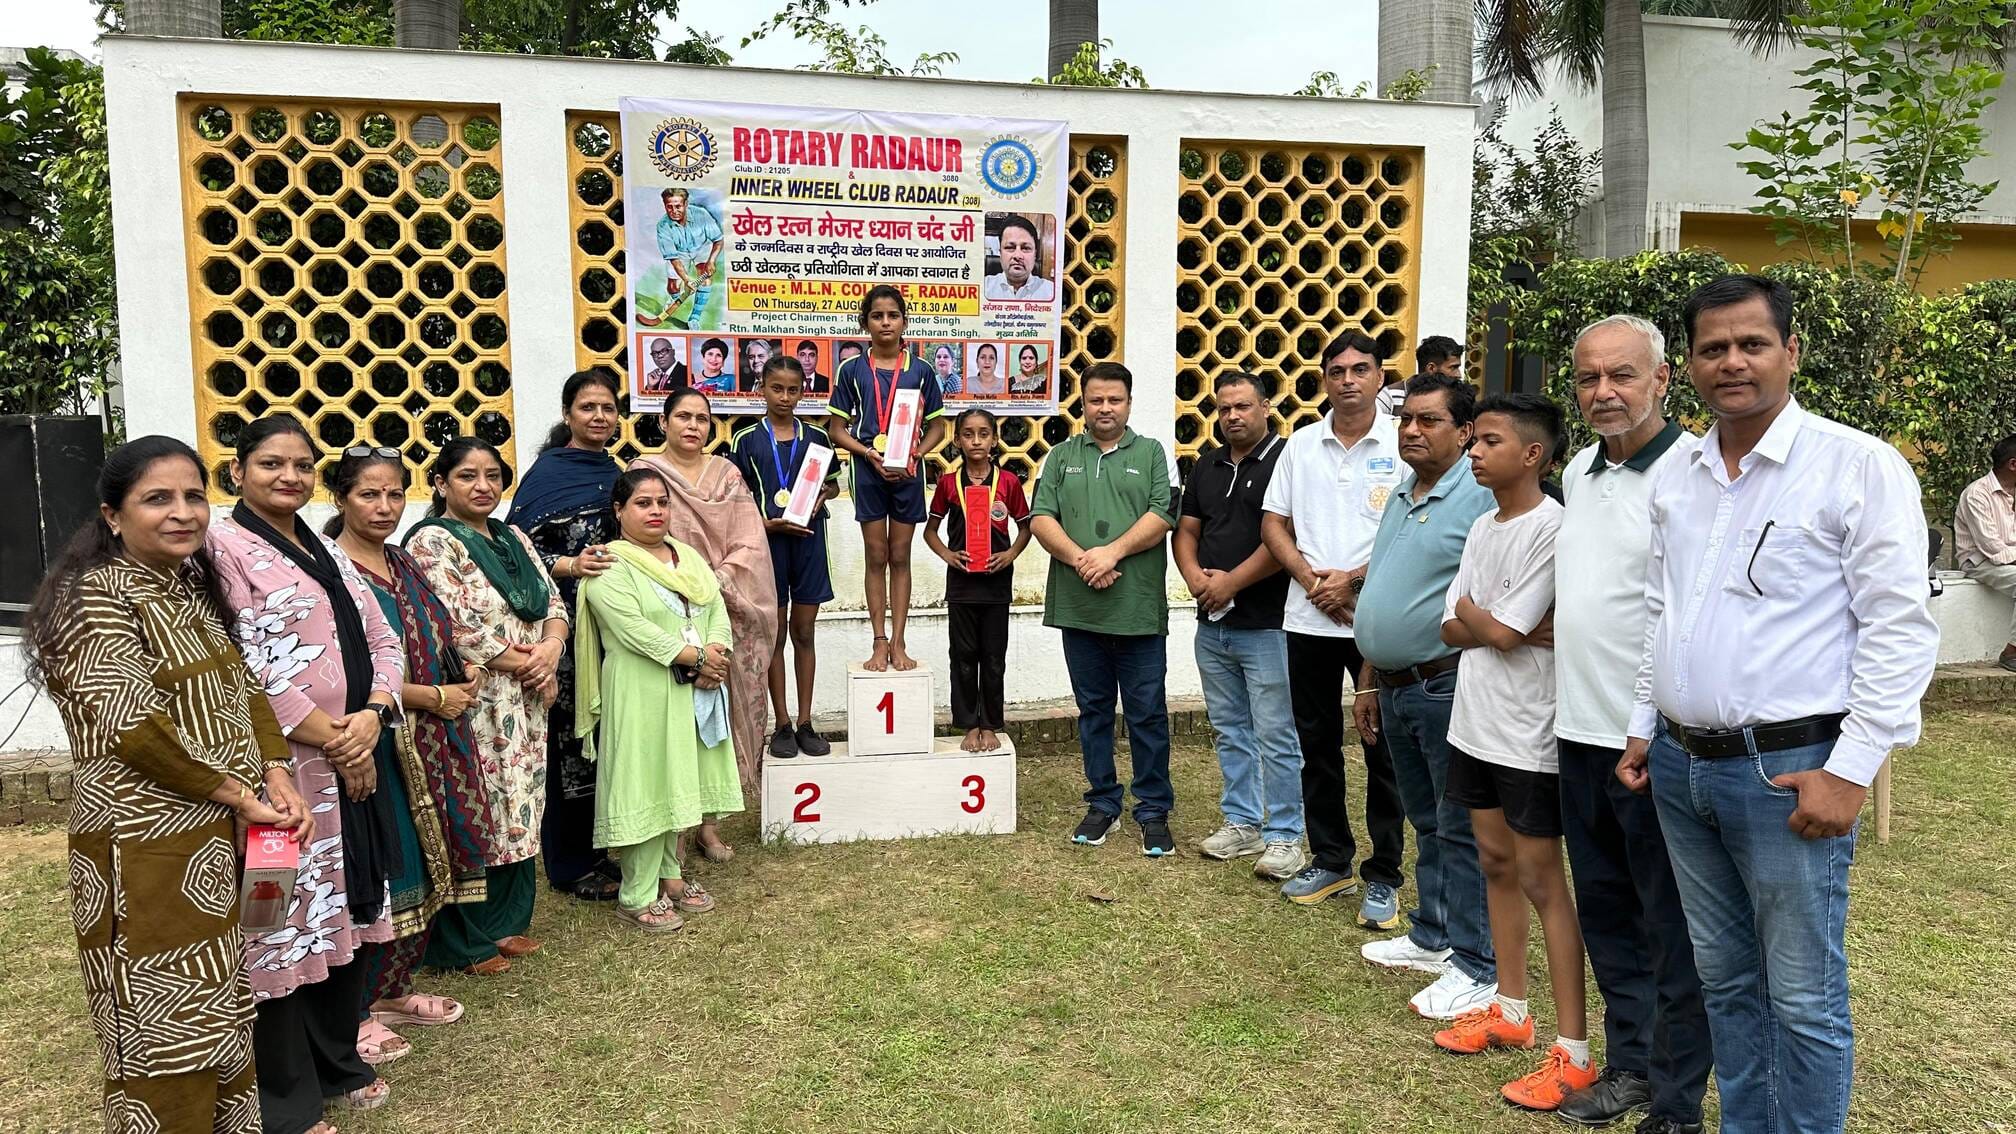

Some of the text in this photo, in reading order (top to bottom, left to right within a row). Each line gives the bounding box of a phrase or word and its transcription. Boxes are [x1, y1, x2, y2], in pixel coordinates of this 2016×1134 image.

[665, 124, 699, 135] ROTARY
[733, 127, 844, 168] ROTARY
[851, 133, 963, 173] RADAUR
[734, 164, 753, 174] Club
[754, 165, 763, 174] ID
[768, 166, 791, 175] 21205
[848, 171, 856, 180] &
[942, 174, 959, 182] 3080
[731, 177, 981, 206] INNER WHEEL CLUB RADAUR (308)
[731, 206, 975, 243] खेल रत्न मेजर ध्यान चंद जी
[735, 238, 966, 260] के जन्मदिवस व राष्ट्रीय खेल दिवस पर आयोजित
[731, 256, 971, 280] छठी खेलकूद प्रतियोगिता में आपका स्वागत है
[730, 280, 777, 294] Venue
[790, 281, 836, 297] M.L.N.
[918, 285, 978, 300] RADAUR
[753, 297, 769, 308] ON
[771, 297, 820, 312] Thursday,
[821, 300, 833, 310] 27
[907, 302, 919, 311] AT
[921, 303, 940, 312] 8.30
[942, 303, 957, 312] AM
[751, 311, 787, 322] Project
[789, 312, 838, 322] Chairmen
[933, 316, 961, 326] Singh
[729, 323, 750, 333] Rtn.
[752, 324, 795, 334] Malkhan
[797, 325, 827, 337] Singh
[876, 692, 894, 734] 1
[793, 782, 822, 823] 2
[960, 775, 986, 814] 3
